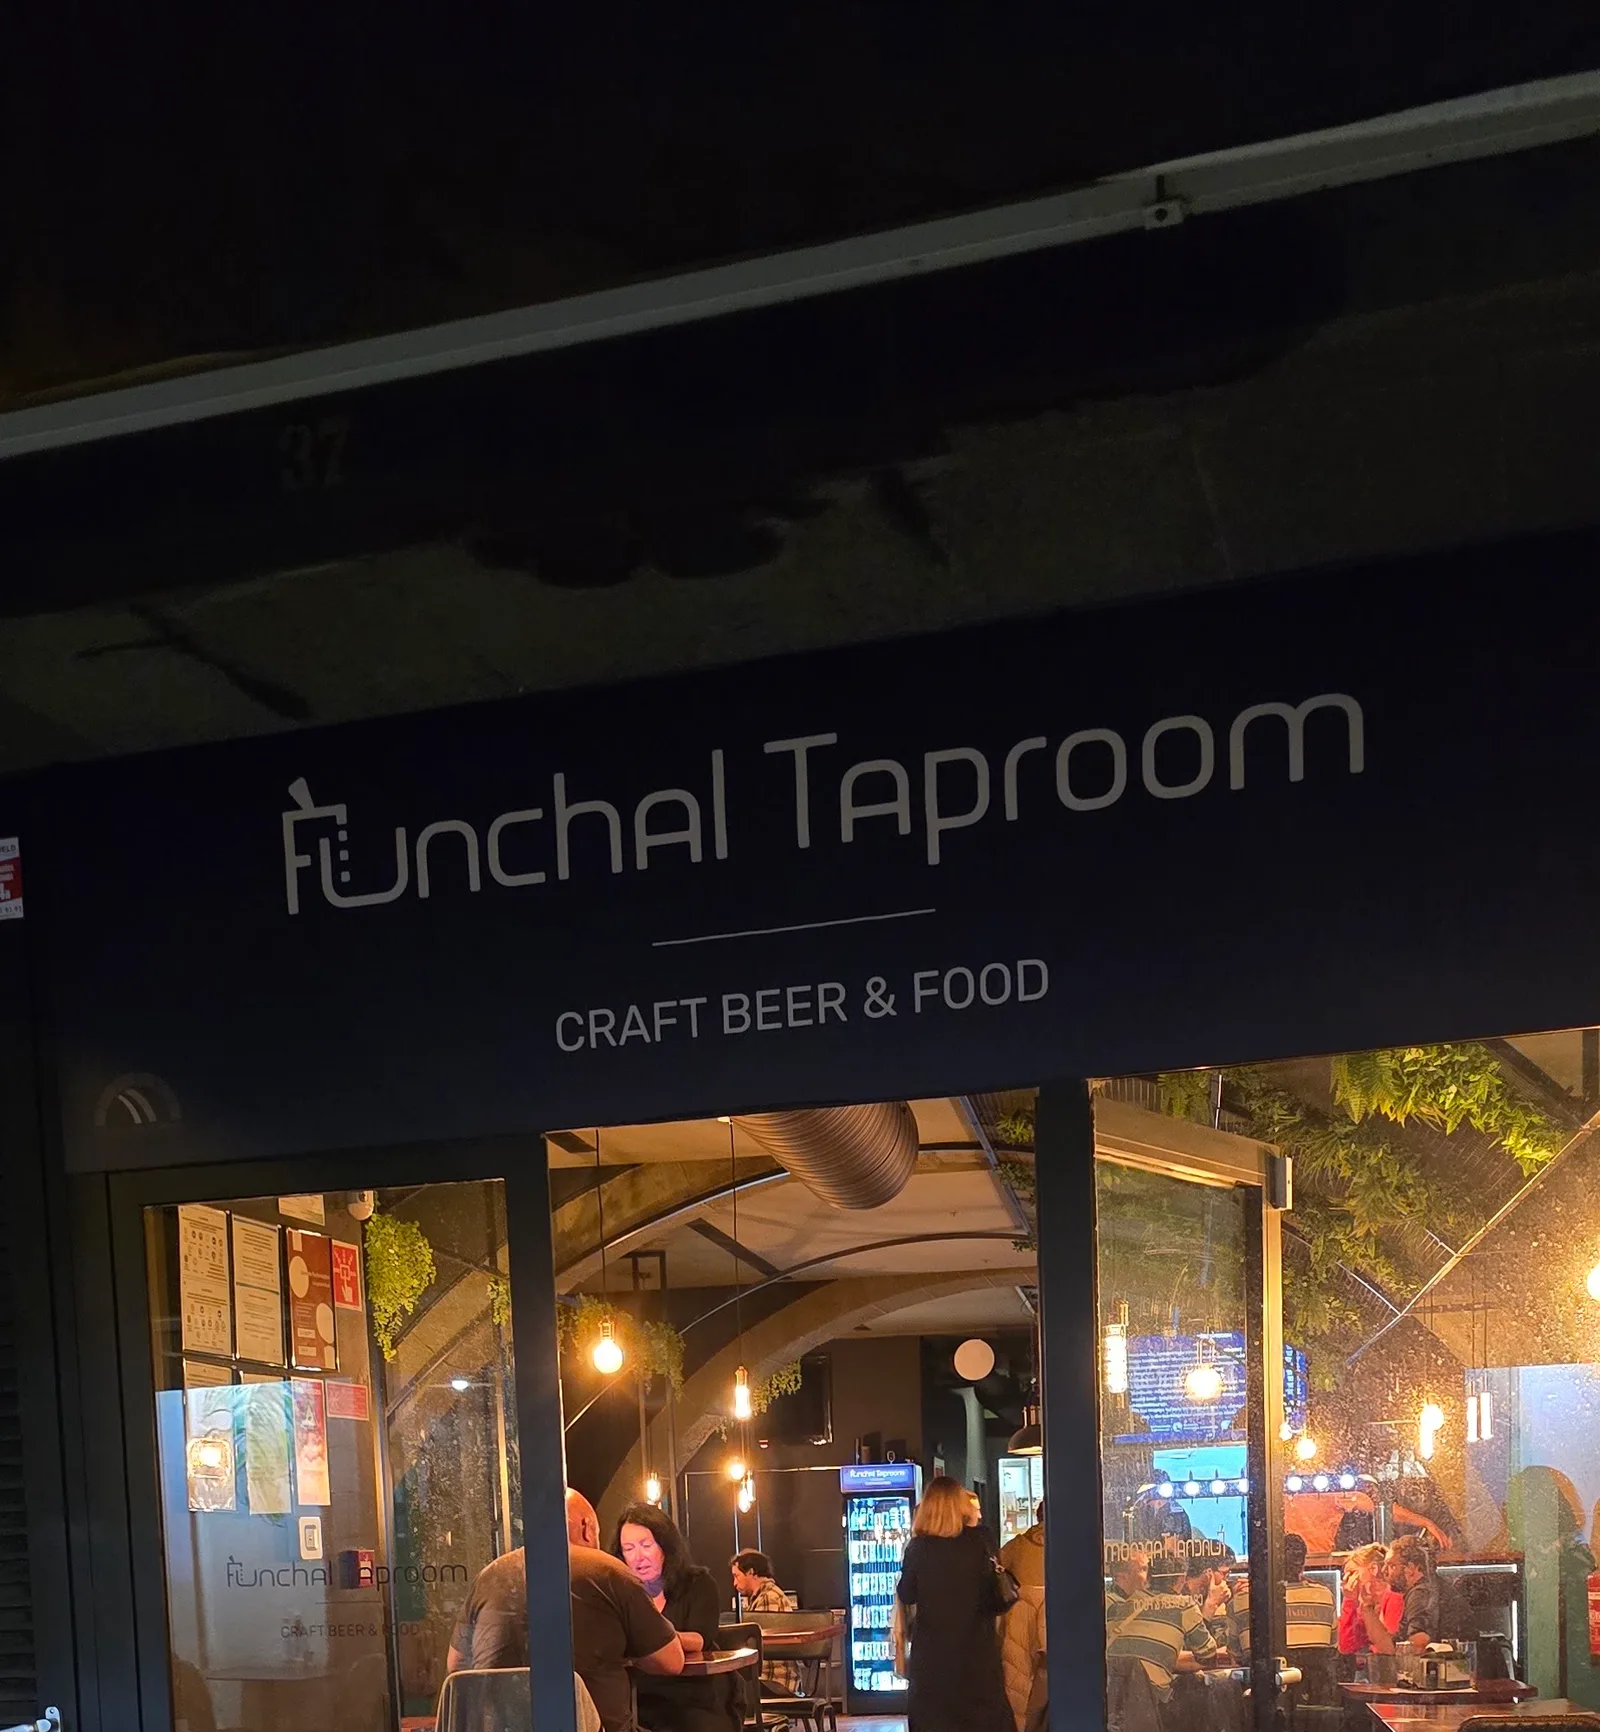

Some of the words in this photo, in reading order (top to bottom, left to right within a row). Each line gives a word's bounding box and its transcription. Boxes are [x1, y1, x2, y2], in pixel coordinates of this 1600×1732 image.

[280, 749, 729, 916] Funchal
[763, 692, 1366, 866] Taproom
[555, 996, 708, 1052] CRAFT
[721, 981, 848, 1034] BEER
[863, 975, 898, 1019] &
[913, 958, 1049, 1013] FOOD
[227, 1555, 333, 1587] Funchal
[342, 1560, 468, 1591] aproom
[281, 1624, 324, 1638] CRAFT
[328, 1624, 364, 1637] BEER
[368, 1624, 377, 1637] &
